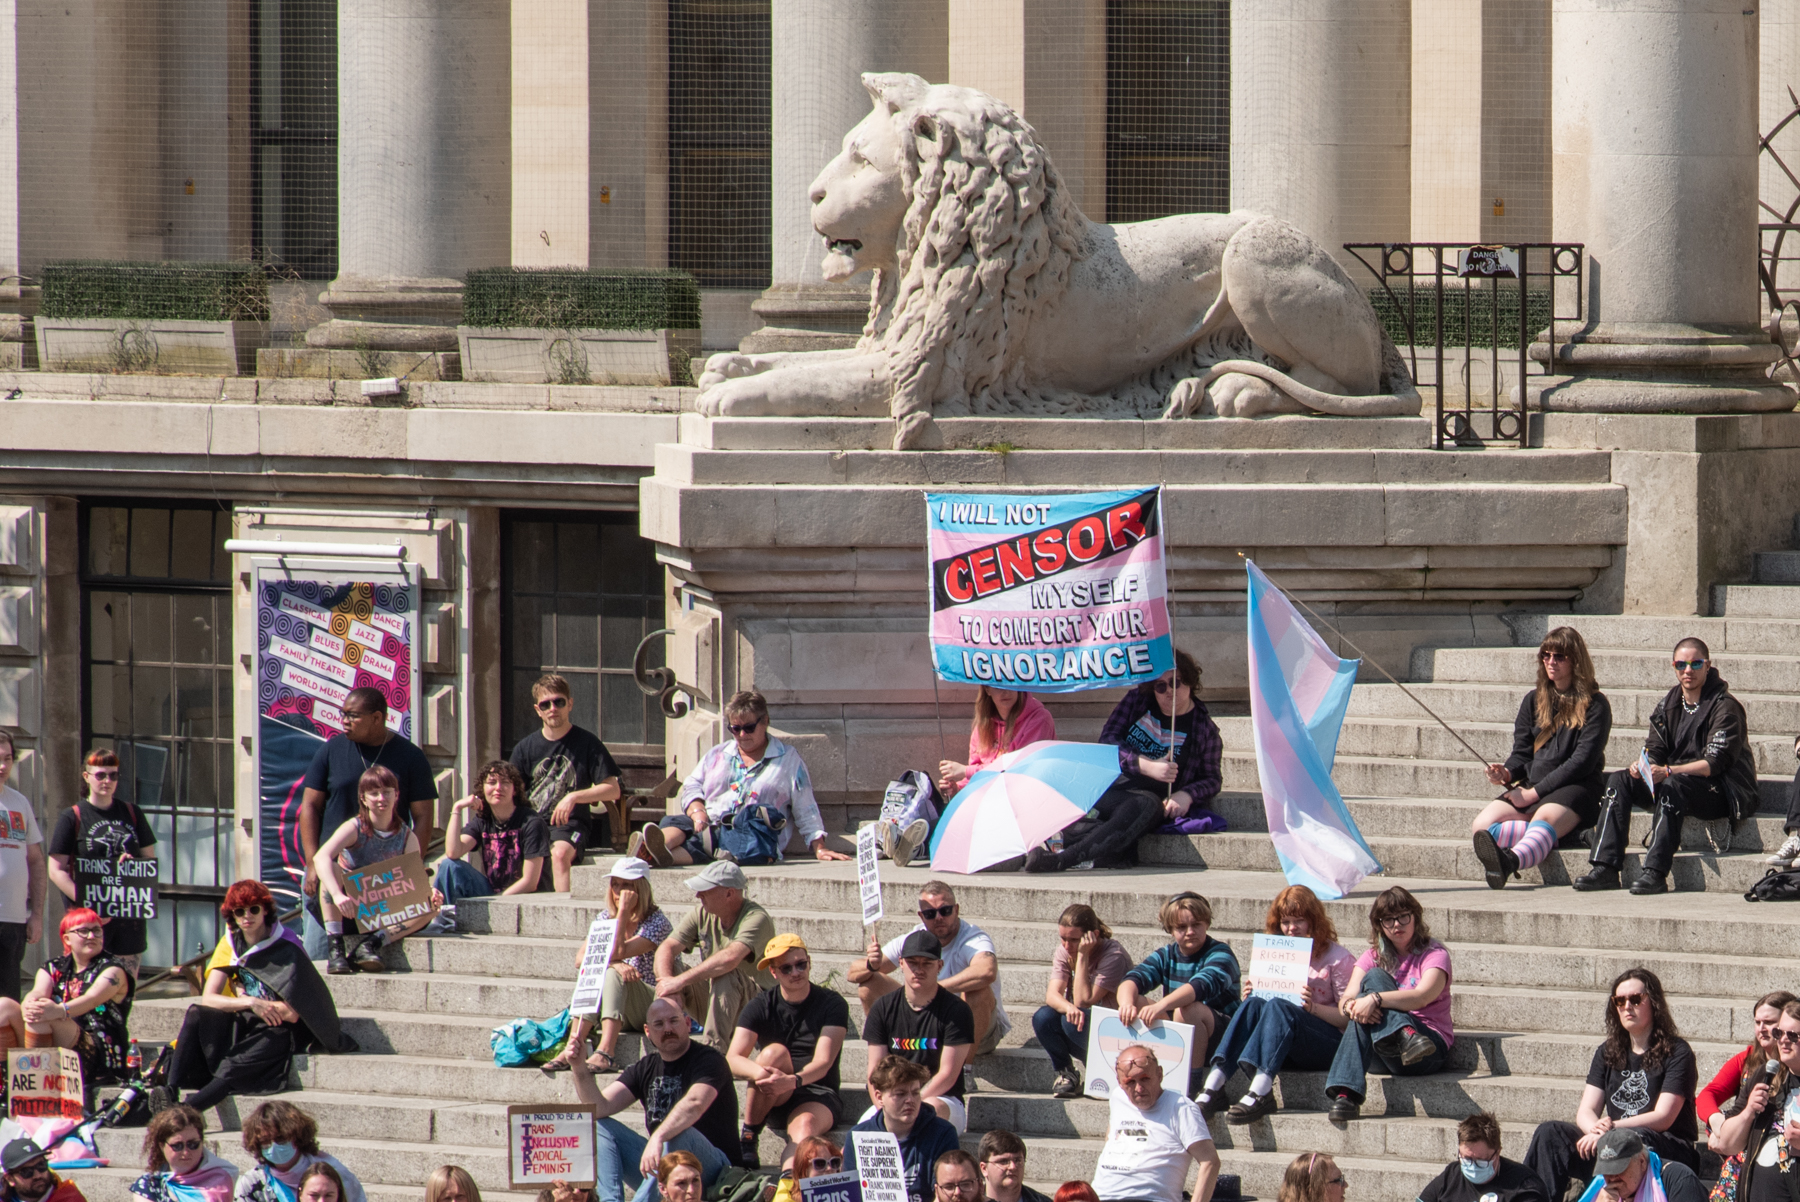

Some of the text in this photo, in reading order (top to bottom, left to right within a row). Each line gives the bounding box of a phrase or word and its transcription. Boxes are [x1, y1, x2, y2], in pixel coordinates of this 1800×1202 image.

[939, 501, 1050, 525] I WILL NOT
[944, 502, 1146, 603] CENSOR
[1031, 574, 1138, 609] MYSELF
[282, 598, 327, 623] CLASSICAL
[374, 612, 401, 630] DANCE
[960, 608, 1147, 646] TO COMFORT YOUR
[314, 633, 340, 651] BLUES
[355, 628, 376, 643] JAZZ
[279, 644, 347, 679] FAMILY THEATRE
[363, 654, 393, 674] DRAMA
[962, 644, 1153, 682] IGNORANCE
[289, 671, 346, 702] WORLD MUSIC
[76, 858, 157, 877] TRANS RIGHTS
[101, 876, 122, 886] ARE
[85, 884, 152, 902] HUMAN
[1265, 938, 1295, 948] TRANS
[1260, 950, 1296, 961] RIGHTS
[1268, 964, 1287, 975] ARE
[17, 1051, 51, 1071] OUR
[12, 1073, 37, 1091] ARE
[534, 1113, 554, 1121] PROUD
[521, 1123, 554, 1136] TRANS
[521, 1136, 579, 1150] INCLUSIVE
[858, 1145, 898, 1157] FIGHT AGAINST
[523, 1150, 567, 1164] RADICAL
[860, 1157, 896, 1167] THE SUPREME
[523, 1163, 572, 1176] FEMINIST
[861, 1168, 899, 1179] COURT RULING
